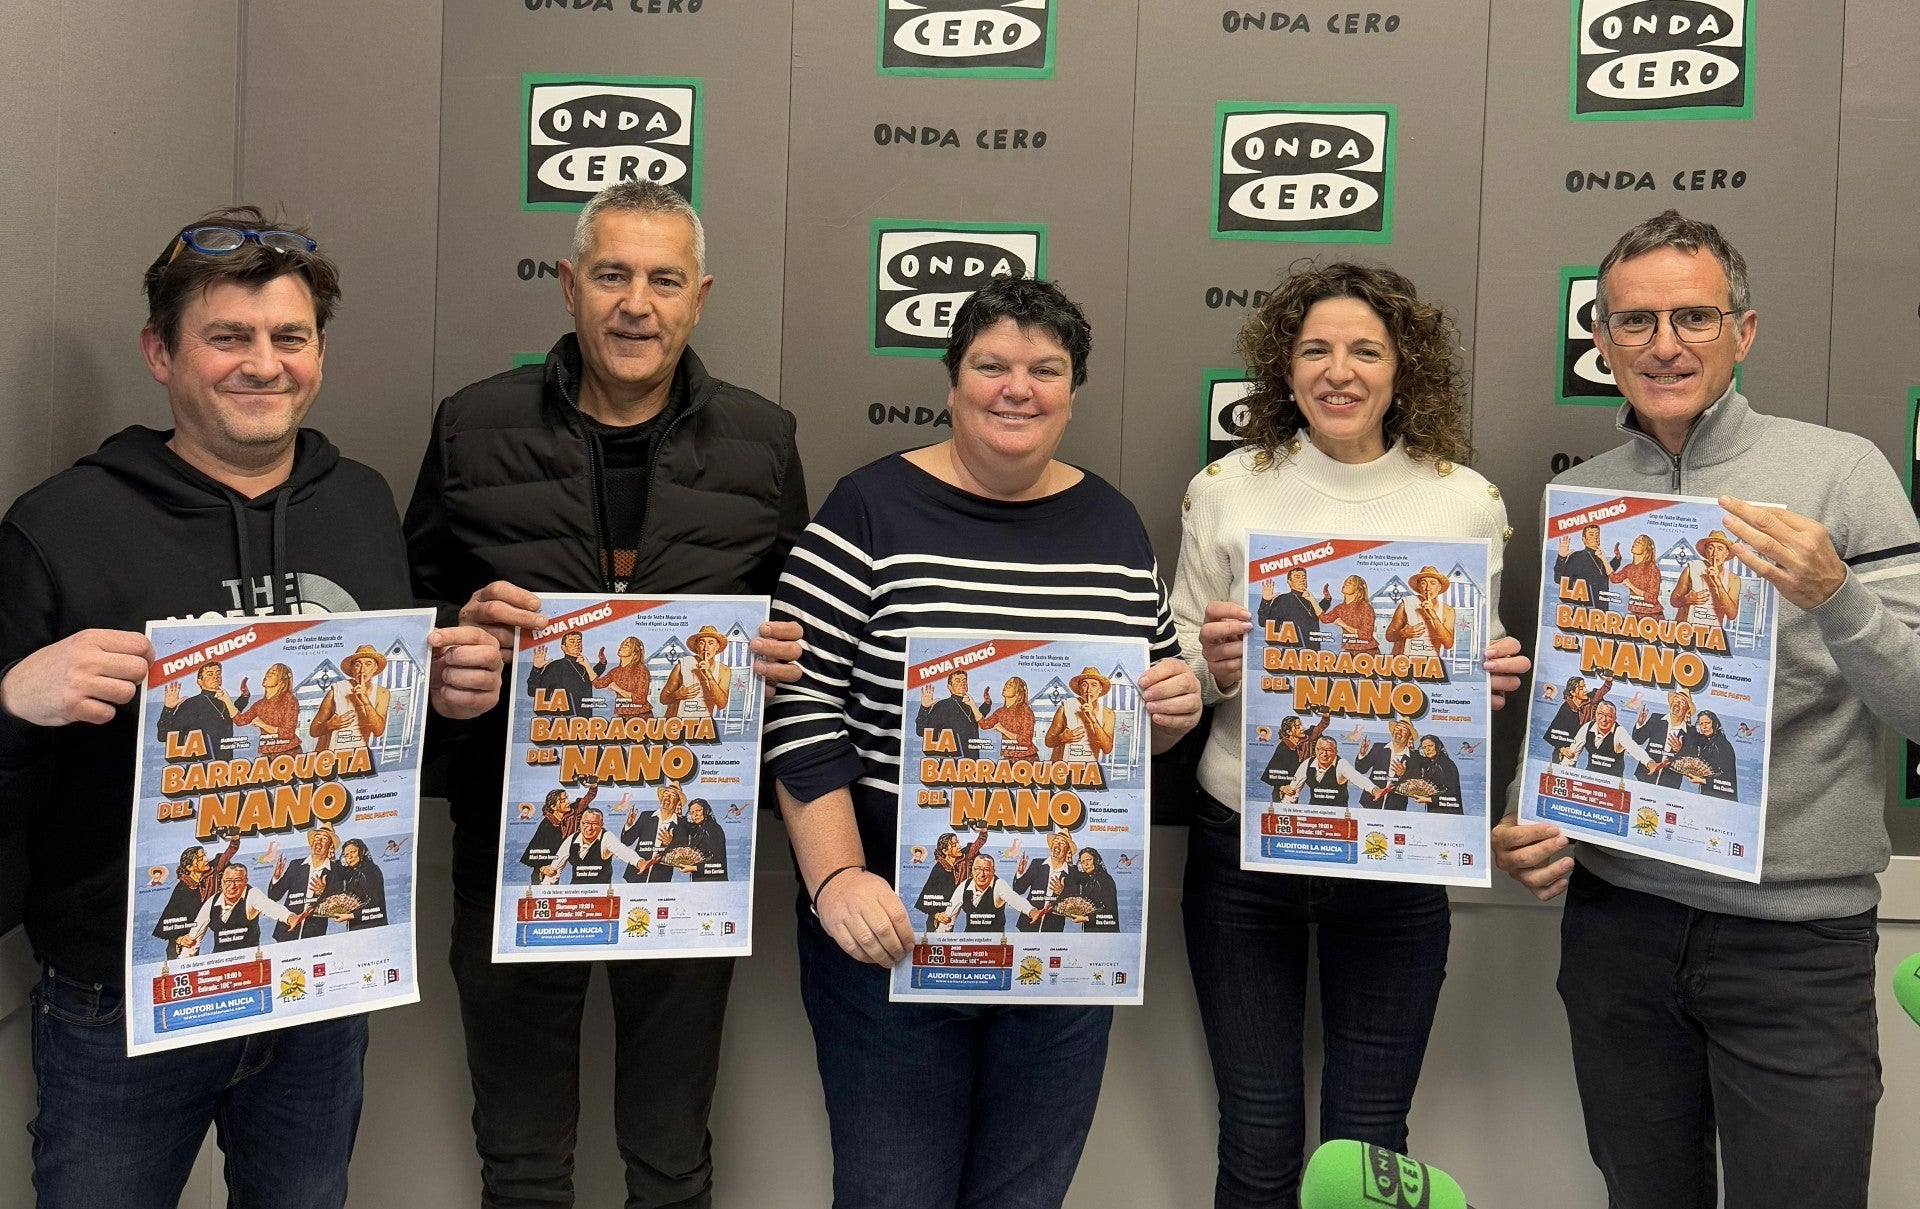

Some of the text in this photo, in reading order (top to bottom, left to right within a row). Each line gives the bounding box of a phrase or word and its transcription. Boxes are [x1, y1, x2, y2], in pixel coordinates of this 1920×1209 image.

[914, 20, 1021, 46] CERO
[1222, 11, 1400, 34] ONDA CERO
[1603, 13, 1719, 39] ONDA
[1608, 61, 1719, 89] CERO
[552, 108, 667, 132] ONDA
[874, 123, 1047, 150] ONDA CERO
[1245, 137, 1360, 160] ONDA
[558, 155, 667, 181] CERO
[1565, 169, 1747, 193] ONDA CERO
[1250, 184, 1358, 210] CERO
[901, 254, 1012, 278] ONDA
[868, 403, 953, 428] ONDA
[222, 572, 298, 609] THE
[1559, 576, 1589, 602] LA
[1264, 619, 1298, 643] LA
[1552, 632, 1704, 687] DEL NANO
[534, 687, 570, 712] LA
[1261, 675, 1423, 714] DEL NANO
[165, 728, 207, 760] LA
[923, 728, 956, 752] LA
[526, 744, 694, 781] DEL NANO
[1556, 778, 1565, 788] 16
[157, 780, 347, 837] DEL NANO
[917, 787, 1081, 826] DEL NANO
[1551, 803, 1581, 815] AUDITORI
[1278, 816, 1288, 825] 16
[536, 900, 547, 909] 16
[931, 946, 942, 955] 16
[174, 975, 187, 987] 16
[172, 1003, 214, 1016] AUDITORI
[227, 996, 254, 1006] NUCIA
